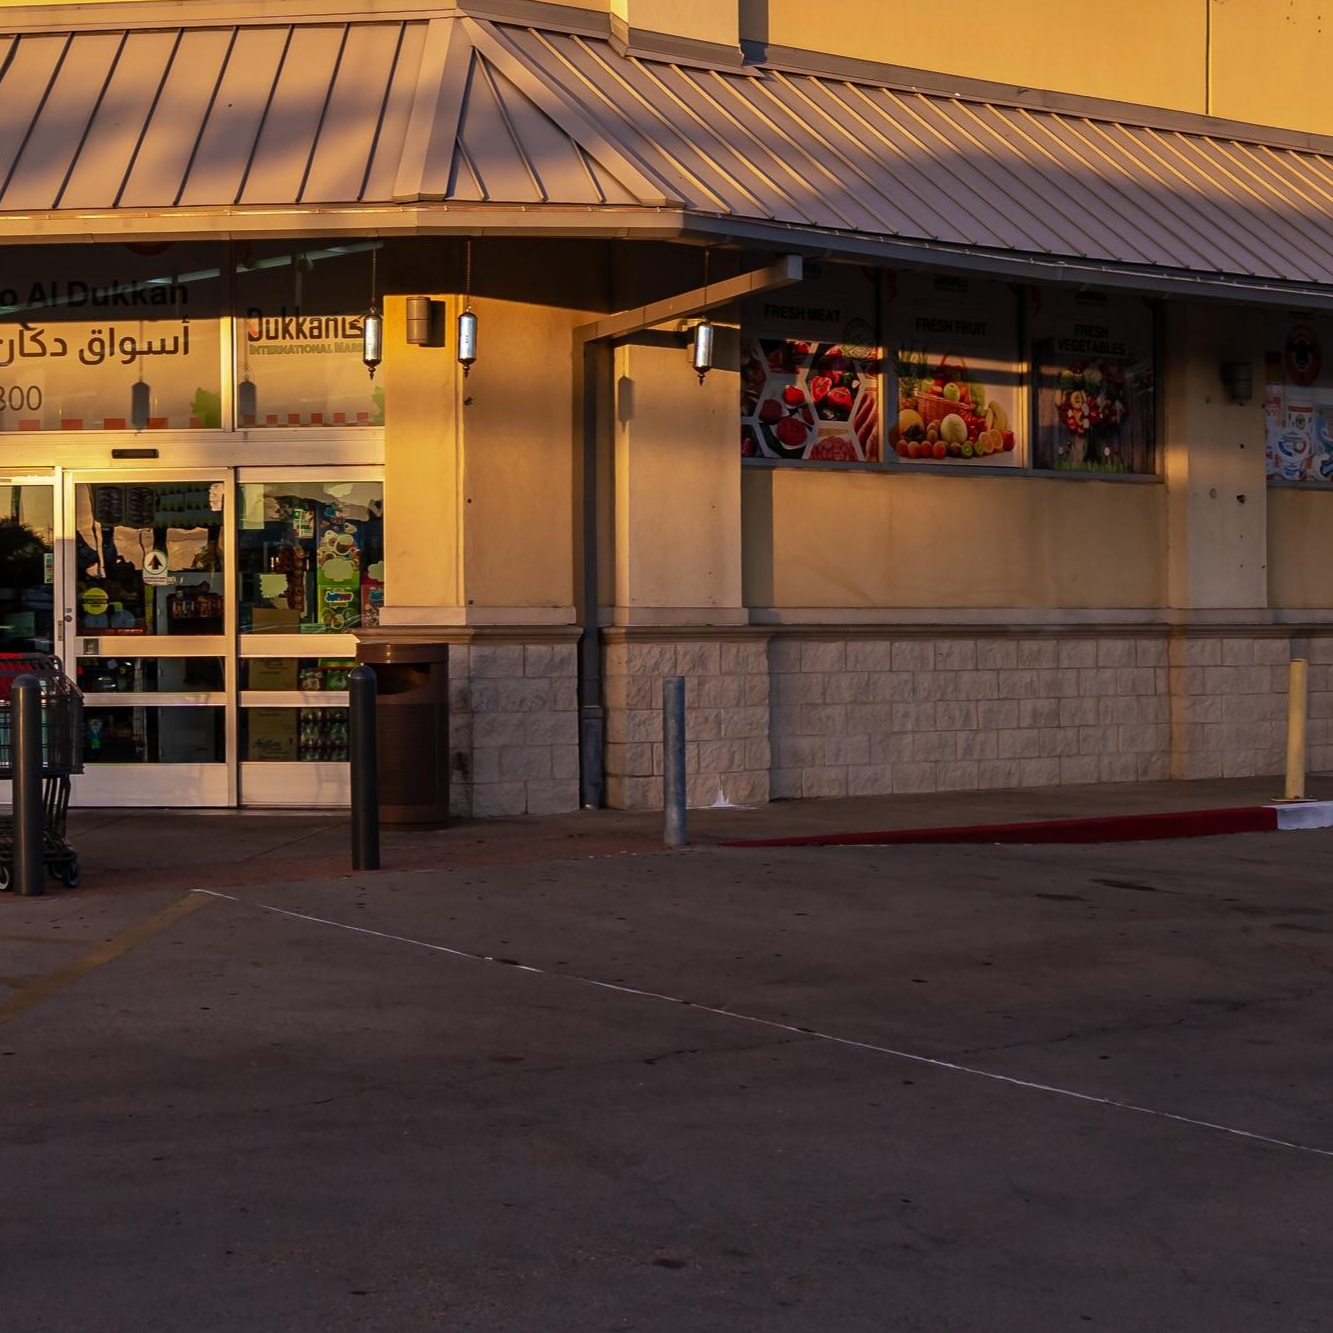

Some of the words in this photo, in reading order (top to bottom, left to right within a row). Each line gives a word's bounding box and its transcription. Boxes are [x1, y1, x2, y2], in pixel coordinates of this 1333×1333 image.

[26, 281, 59, 308] Al
[68, 280, 189, 308] Dukkan
[763, 303, 804, 321] FRESH
[808, 308, 843, 323] MEAT
[915, 317, 953, 334] FRESH
[955, 321, 988, 337] FRUIT
[1074, 323, 1109, 339] FRESH
[77, 315, 191, 366] أسواق
[1057, 337, 1126, 356] VEGETABLES
